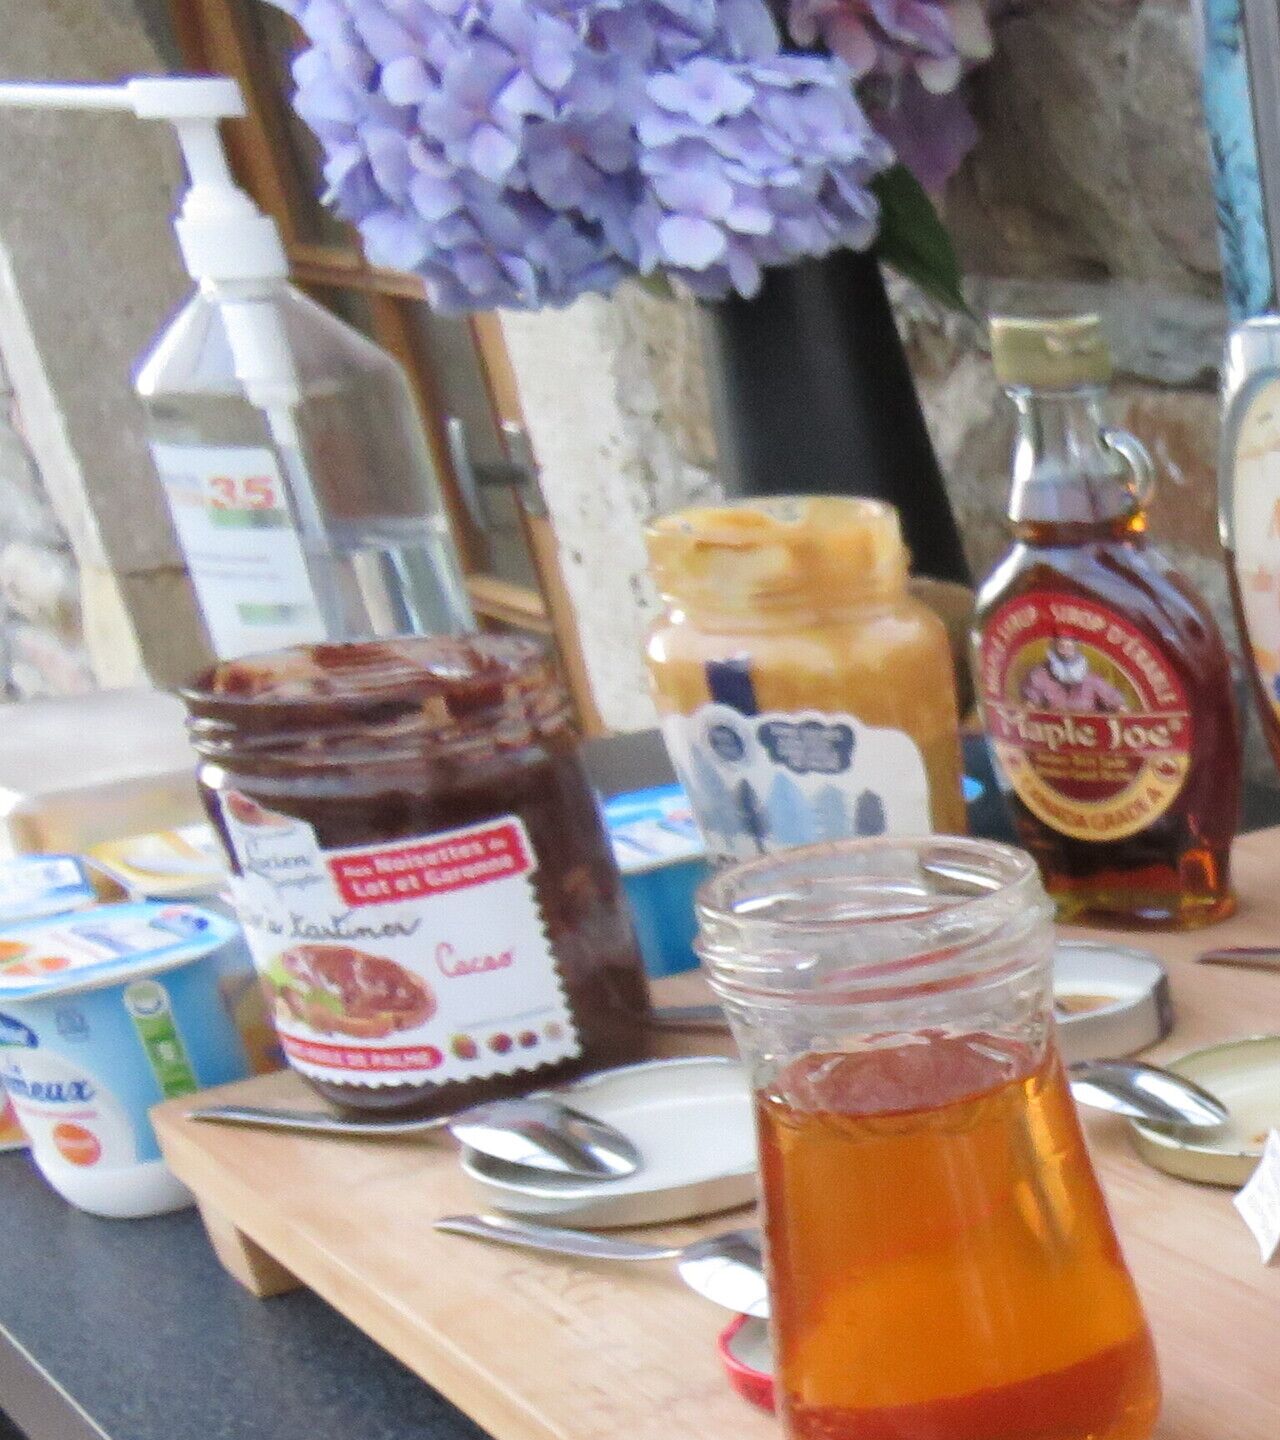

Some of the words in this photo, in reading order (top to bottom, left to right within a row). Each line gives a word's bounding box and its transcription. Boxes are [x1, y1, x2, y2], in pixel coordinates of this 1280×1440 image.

[1049, 601, 1108, 632] SIROP
[989, 701, 1098, 752] Maple
[1107, 715, 1173, 751] Joe
[350, 878, 392, 898] Lot
[393, 873, 423, 893] et
[422, 853, 516, 888] Garonne
[373, 841, 488, 874] Noisettes
[433, 941, 516, 979] Cacao
